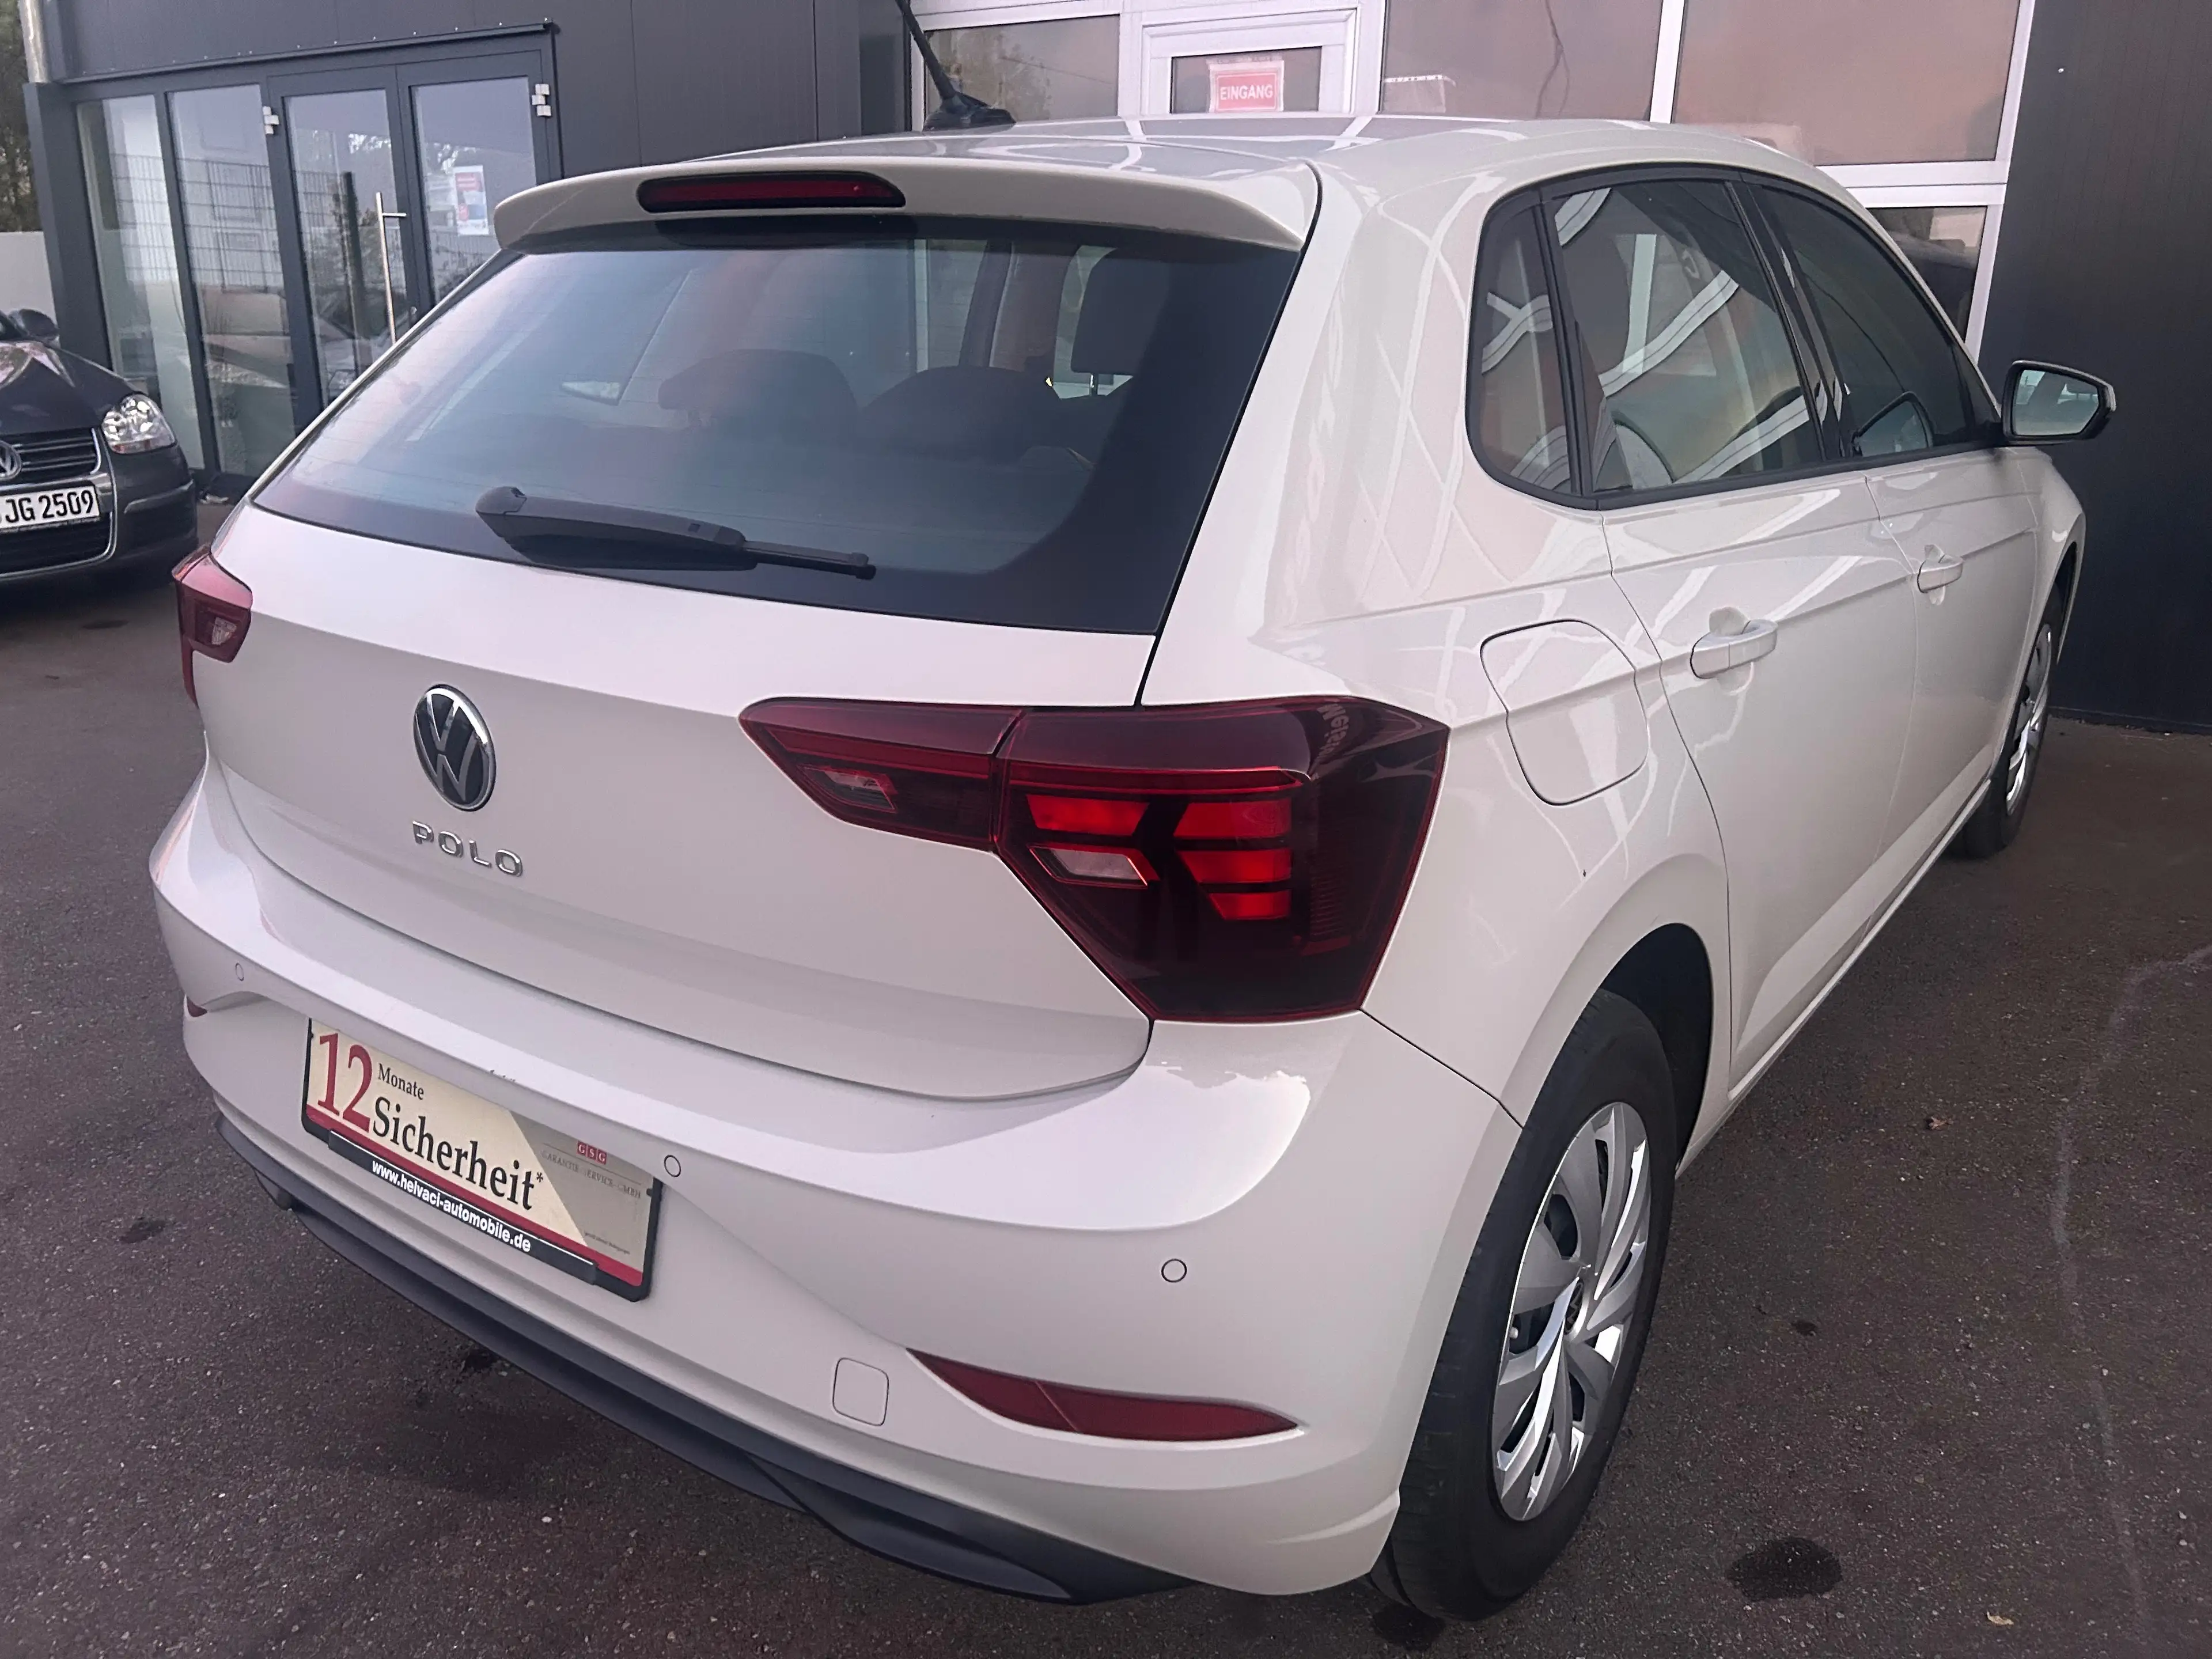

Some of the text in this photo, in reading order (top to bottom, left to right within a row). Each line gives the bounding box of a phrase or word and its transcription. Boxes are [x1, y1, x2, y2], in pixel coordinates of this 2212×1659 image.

[1219, 84, 1274, 101] EINGANG
[5, 490, 93, 523] JG 2509
[412, 820, 524, 877] POLO
[317, 1032, 373, 1133] 12
[378, 1063, 425, 1100] Monate
[372, 1160, 531, 1252] www.helvaci-automobile.de
